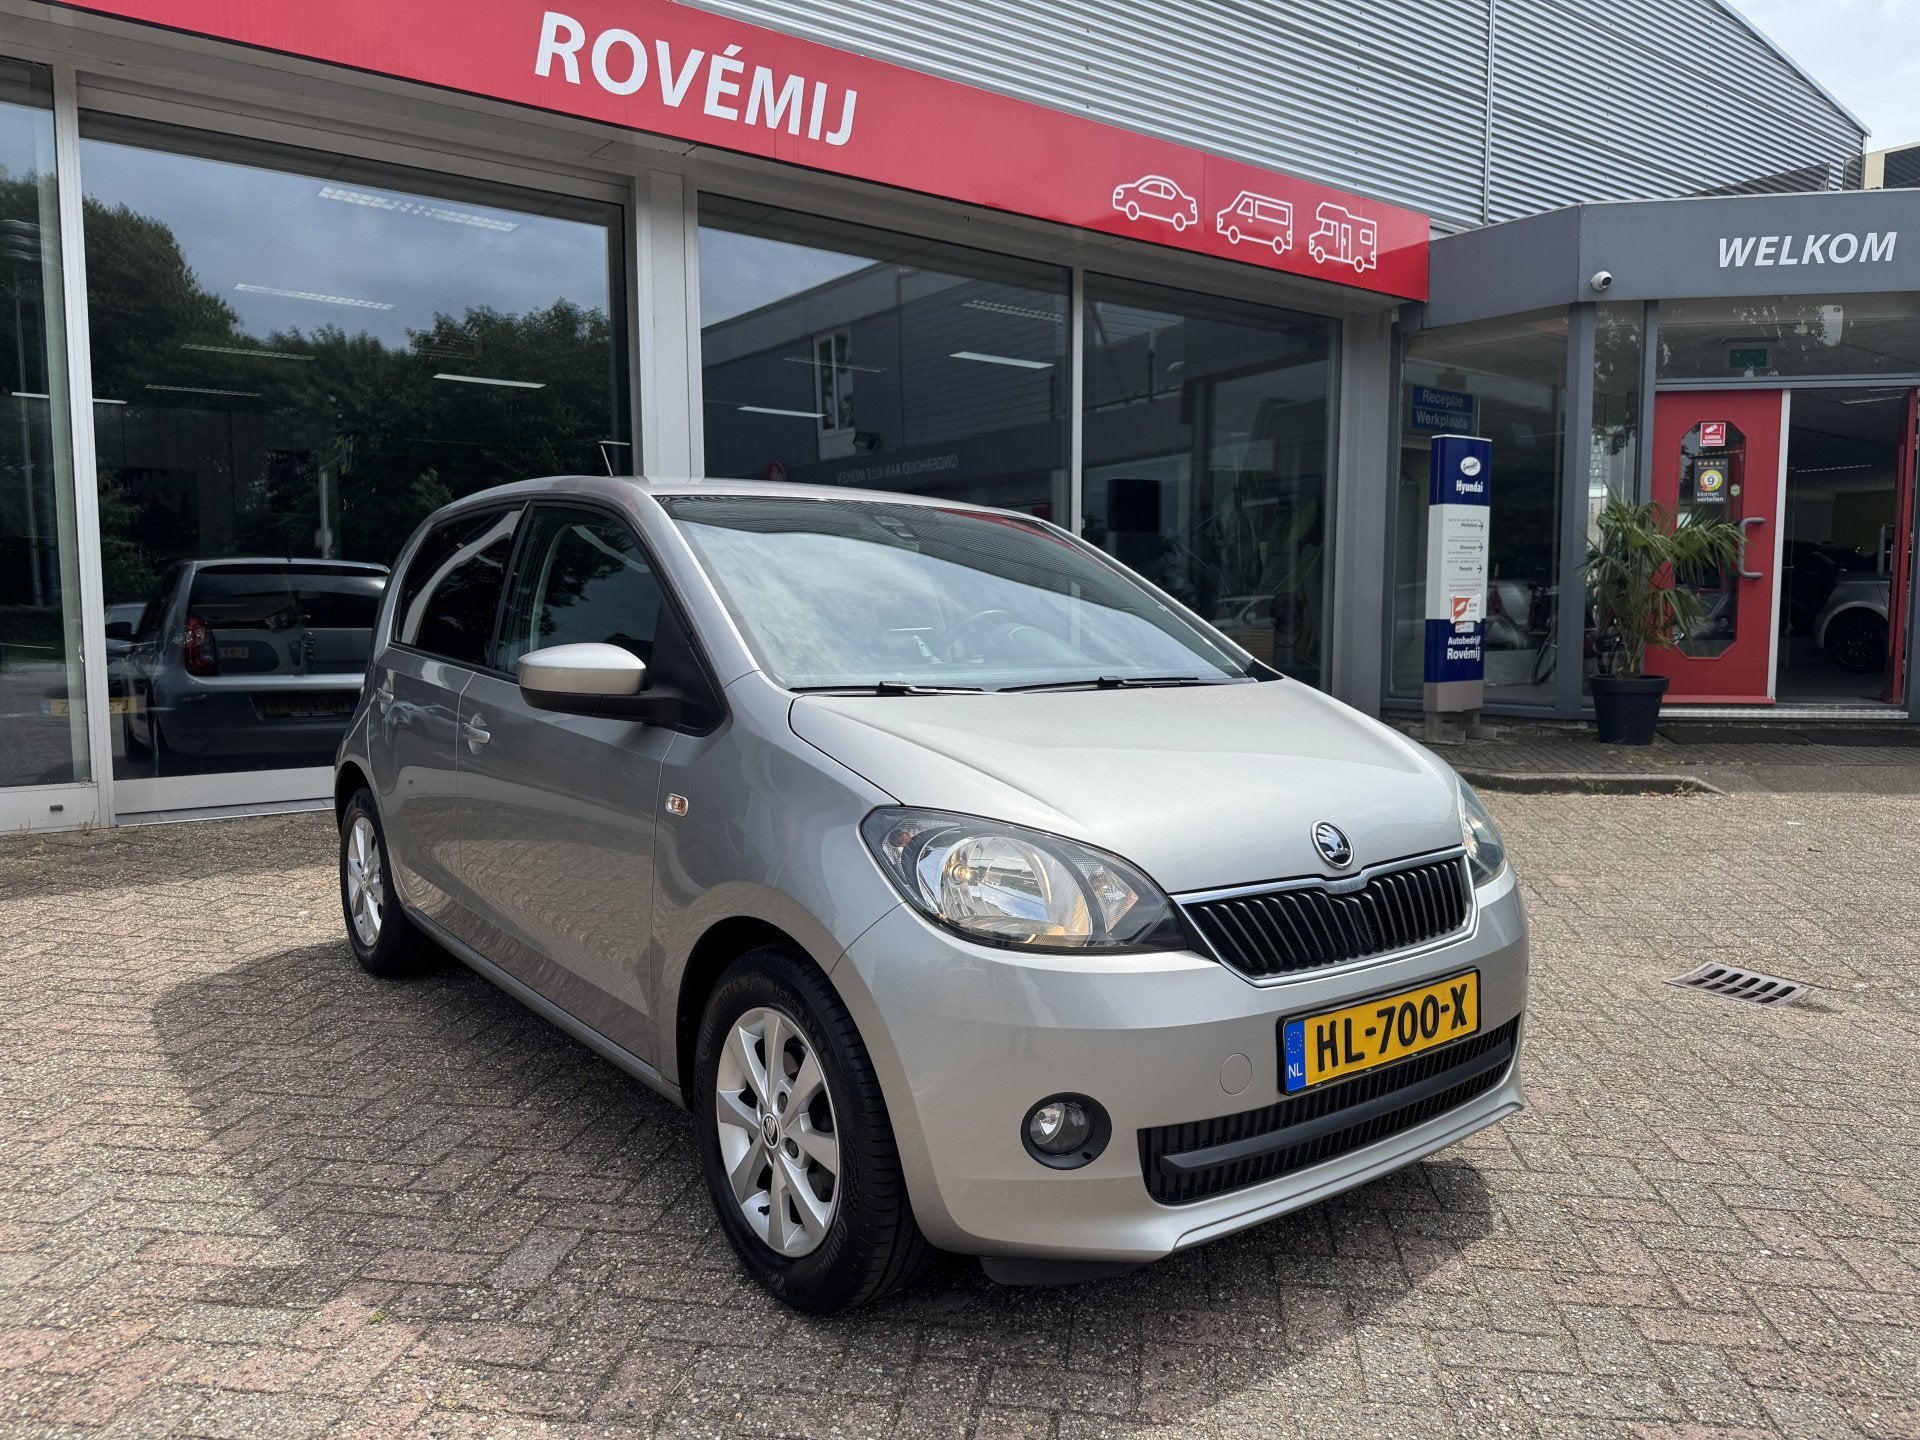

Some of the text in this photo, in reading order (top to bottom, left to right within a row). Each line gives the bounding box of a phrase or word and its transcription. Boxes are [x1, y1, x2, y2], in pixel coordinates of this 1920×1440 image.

[534, 11, 858, 147] ROVÉMIJ
[1719, 231, 1898, 268] WELKOM
[1422, 390, 1464, 408] Receptie
[1416, 410, 1468, 429] Werkplaats
[1456, 479, 1484, 495] Hyundai
[1707, 476, 1715, 486] 9
[1447, 635, 1482, 646] Autobedrijf
[1446, 646, 1481, 662] Rovémij
[1316, 983, 1467, 1072] HL-700-X
[1288, 1062, 1303, 1080] NL
